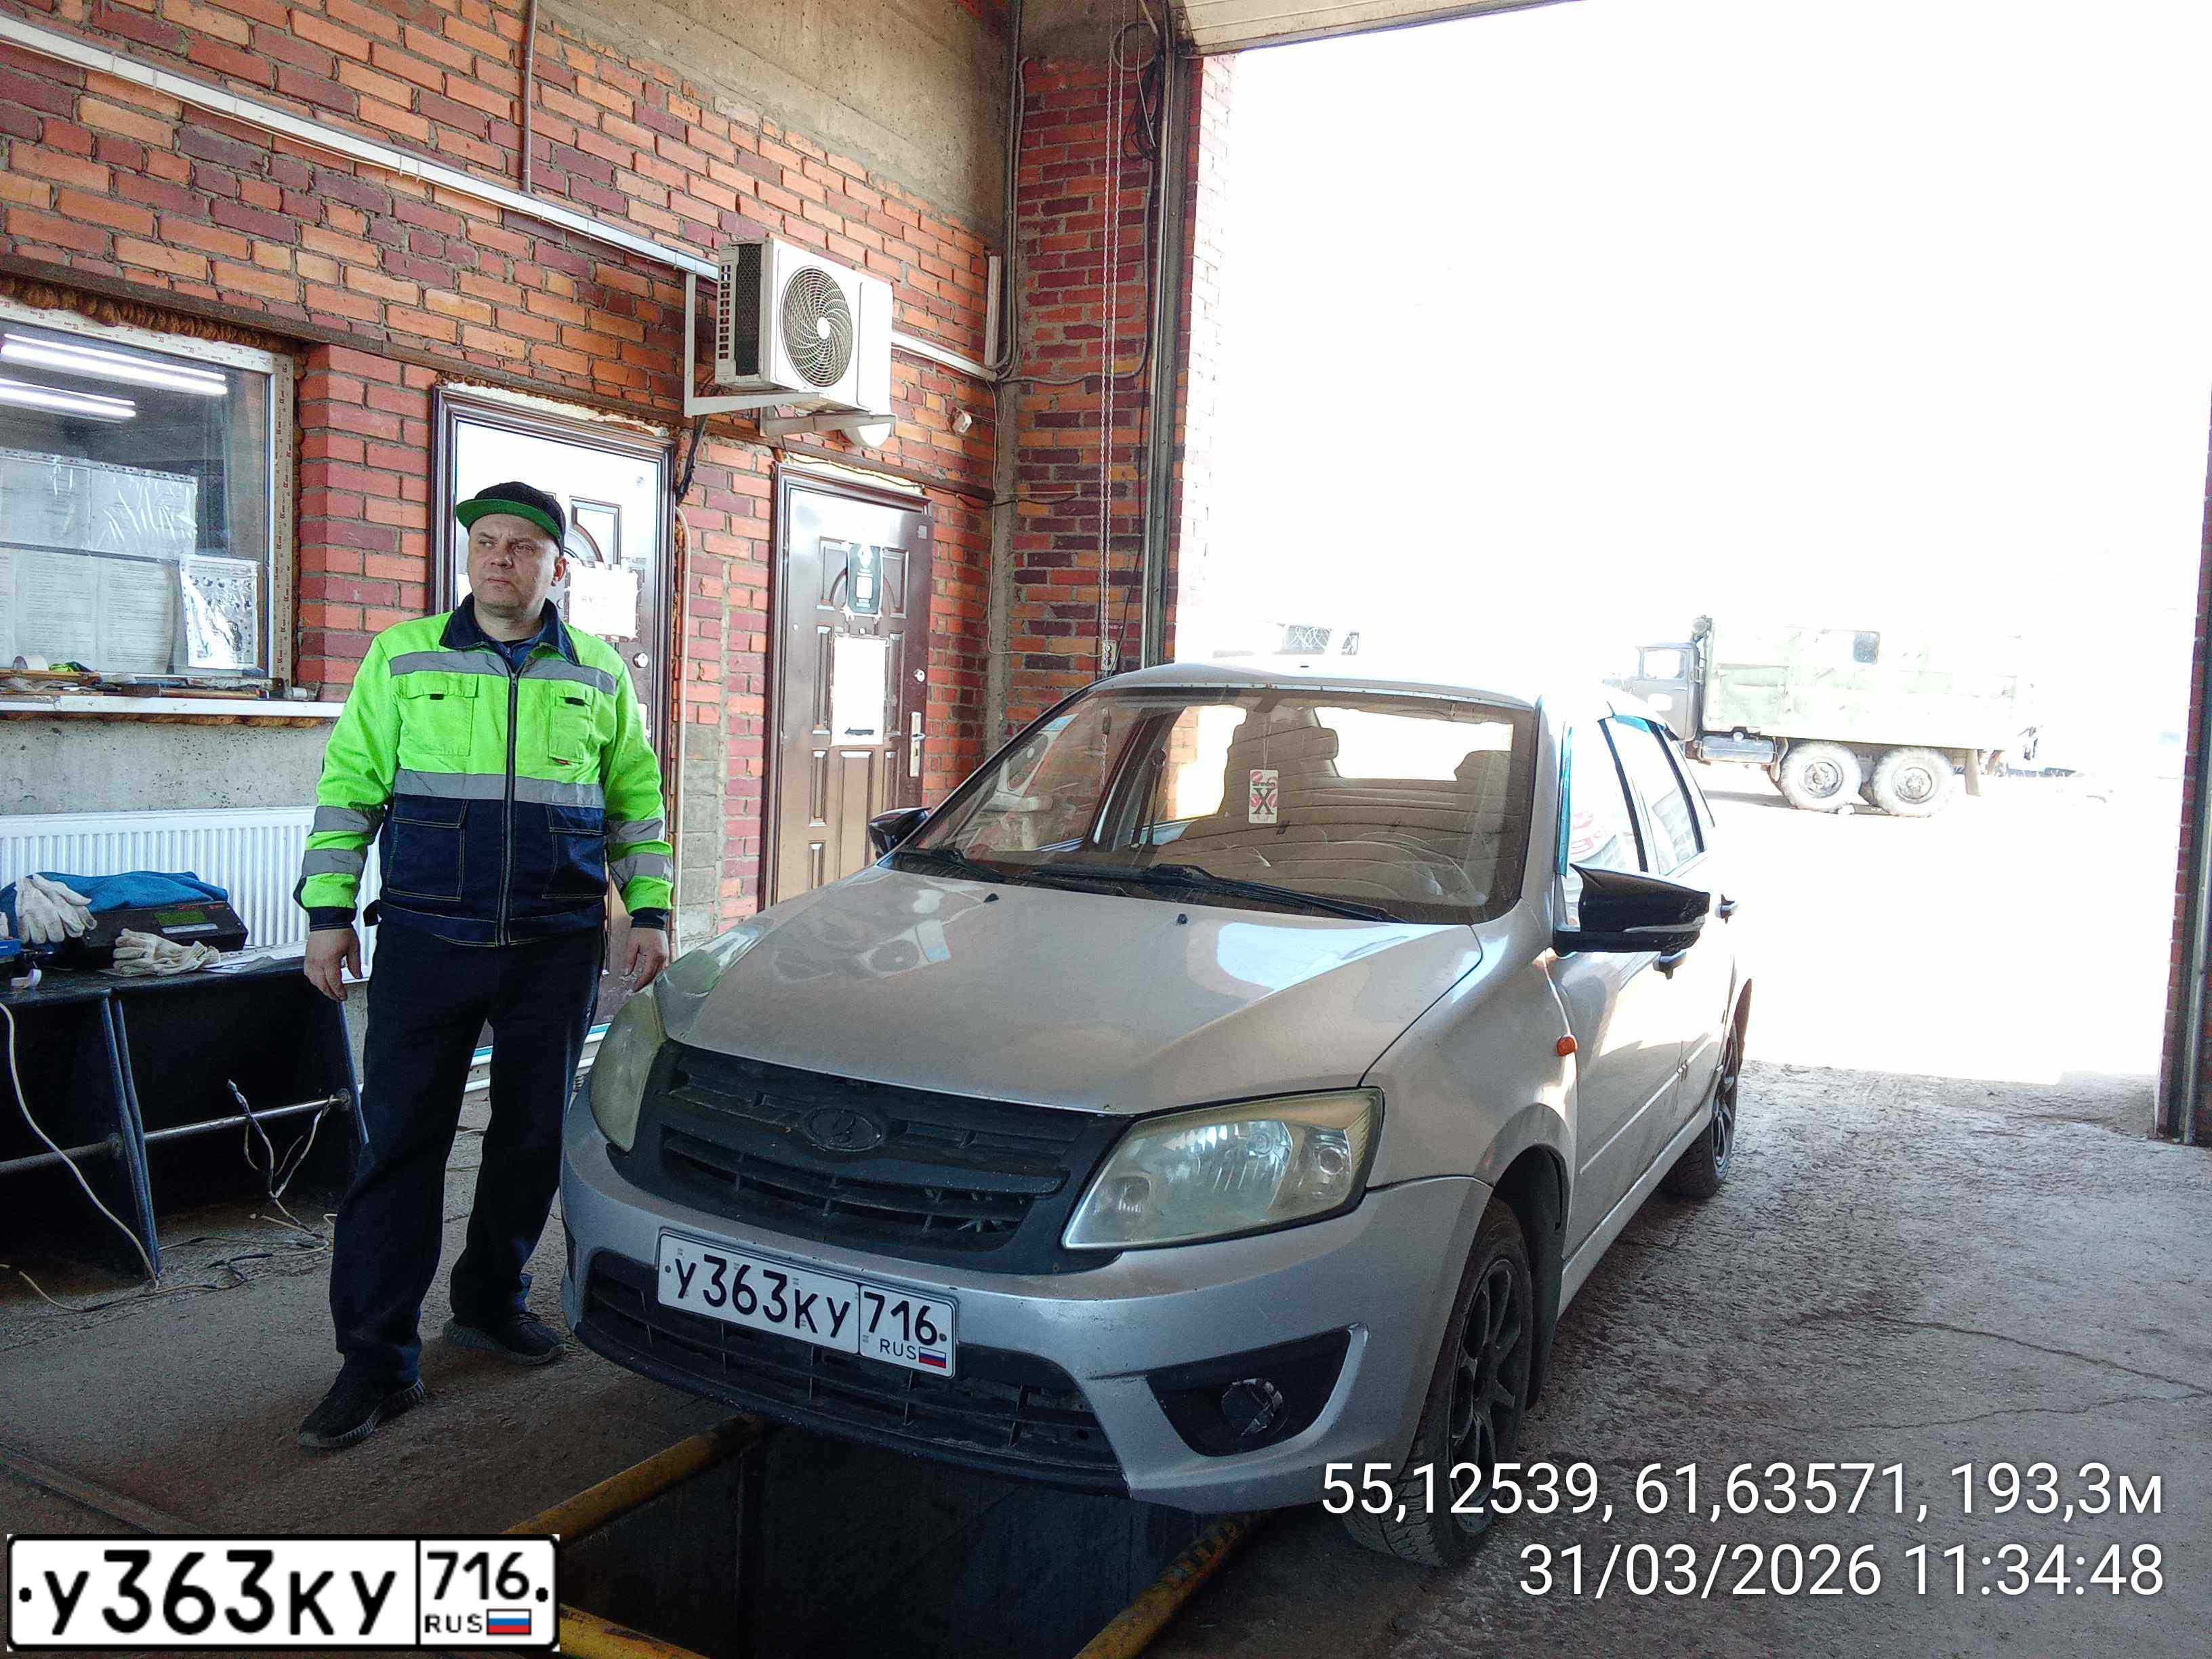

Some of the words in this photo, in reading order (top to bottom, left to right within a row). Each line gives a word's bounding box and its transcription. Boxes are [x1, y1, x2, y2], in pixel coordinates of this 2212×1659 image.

[1252, 787, 1275, 815] X
[675, 1254, 851, 1338] У363КУ
[863, 1290, 937, 1346] 716
[880, 1338, 917, 1360] RUS
